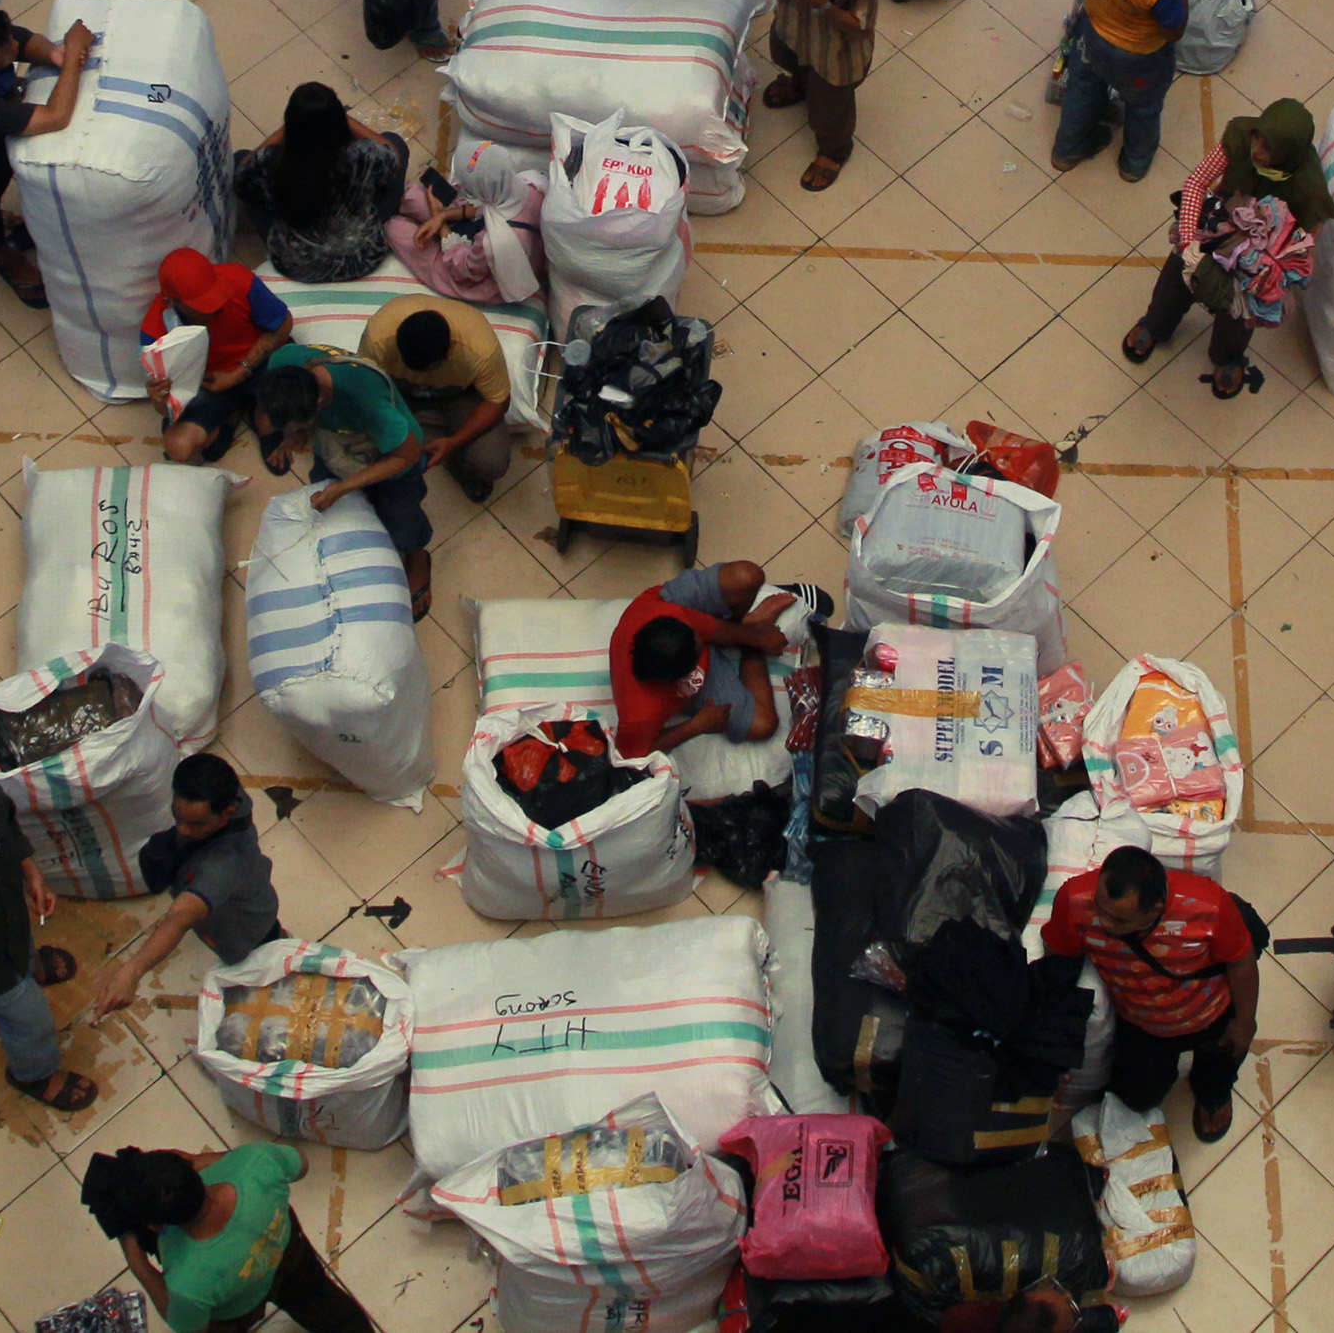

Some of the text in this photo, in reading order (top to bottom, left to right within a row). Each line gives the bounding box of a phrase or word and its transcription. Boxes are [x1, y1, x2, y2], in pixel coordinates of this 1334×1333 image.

[932, 494, 978, 513] AYOLA
[934, 656, 956, 763] SUPER MODEL
[979, 665, 1004, 758] S M
